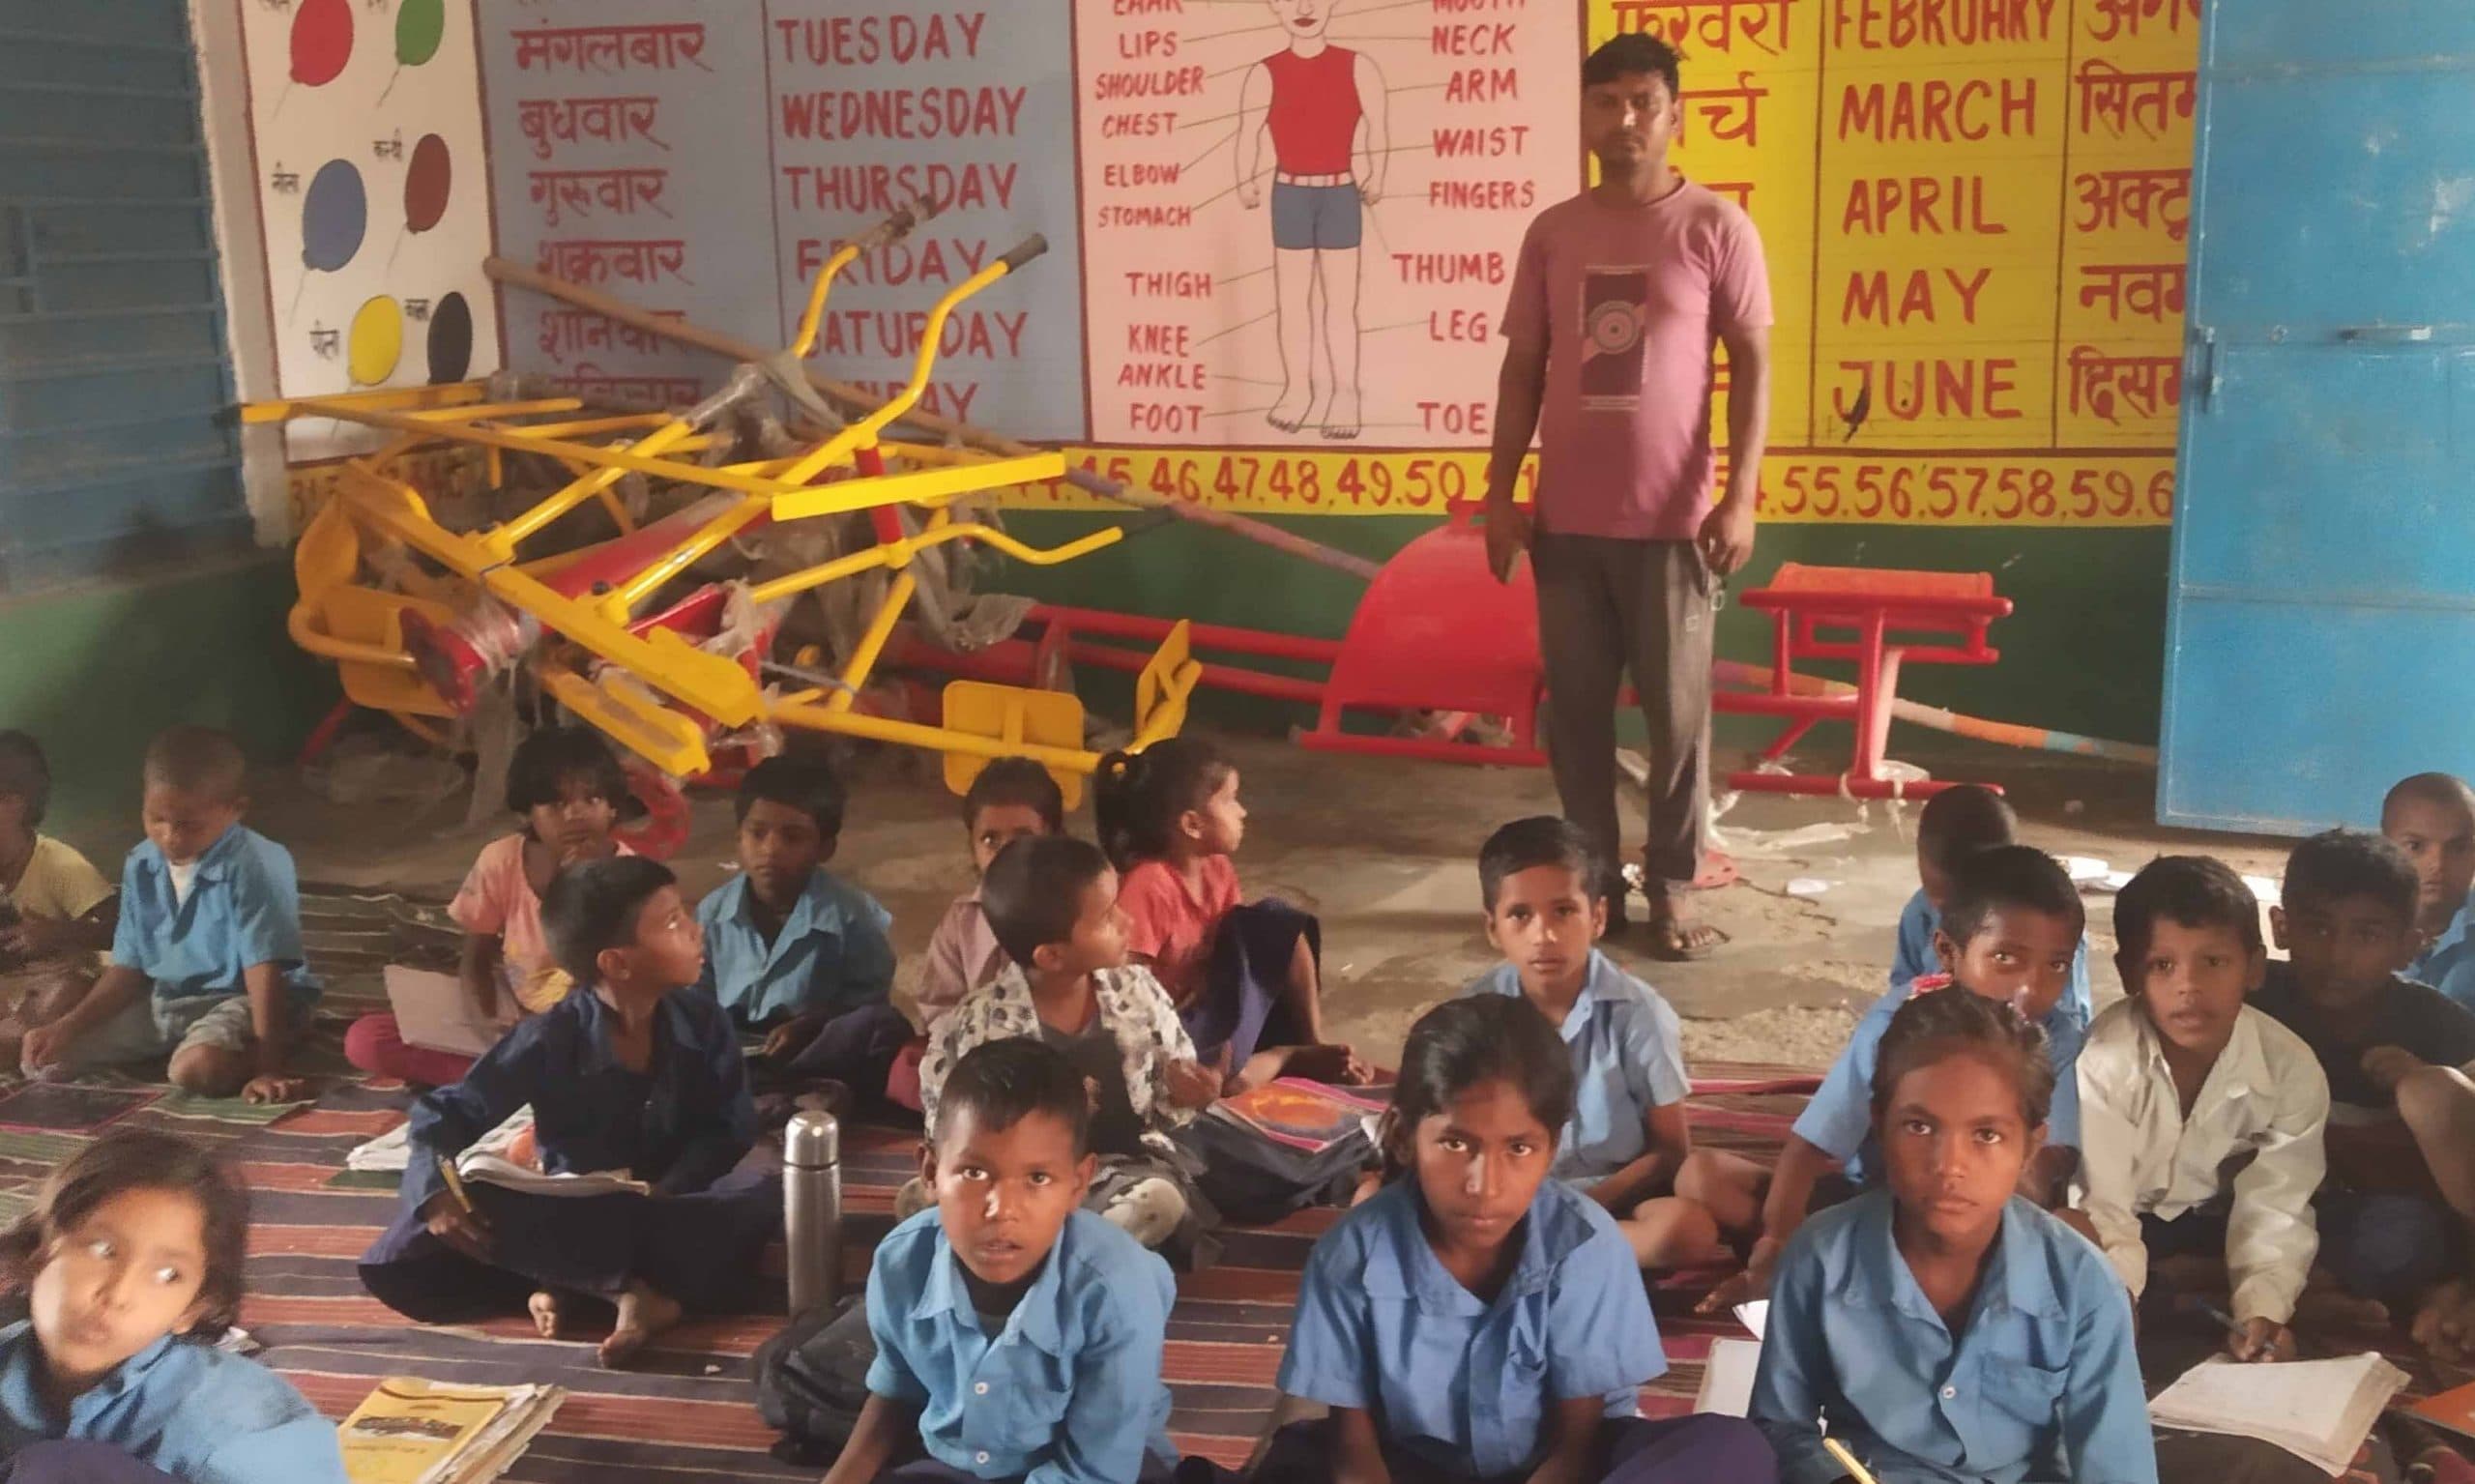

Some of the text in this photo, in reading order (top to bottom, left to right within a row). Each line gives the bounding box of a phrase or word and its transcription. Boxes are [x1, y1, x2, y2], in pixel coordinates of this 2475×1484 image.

[775, 13, 984, 65] TUESDAY
[1120, 31, 1178, 58] LIPS
[1432, 24, 1516, 55] NECK
[1095, 65, 1205, 101] SHOULDER
[1445, 69, 1518, 102] ARM
[781, 86, 1027, 140] WEDNESDAY
[1101, 113, 1178, 139] CHEST
[1839, 77, 2035, 142] MARCH
[518, 98, 673, 160] बुधवार
[1433, 126, 1529, 158] WAIST
[781, 162, 1018, 214] THURSDAY
[1104, 161, 1180, 188] ELBOW
[1430, 181, 1535, 210] FINGERS
[1842, 176, 2009, 235] APRIL
[1098, 206, 1191, 228] STOMACH
[1391, 252, 1505, 284] THUMB
[1125, 272, 1211, 298] THIGH
[1842, 267, 1993, 327] MAY
[1127, 325, 1189, 358] KNEE
[1430, 309, 1487, 342] LEG
[1118, 364, 1207, 391] ANKLE
[1832, 359, 2024, 424] JUNE
[1129, 402, 1205, 433] FOOT
[1415, 402, 1489, 435] TOE
